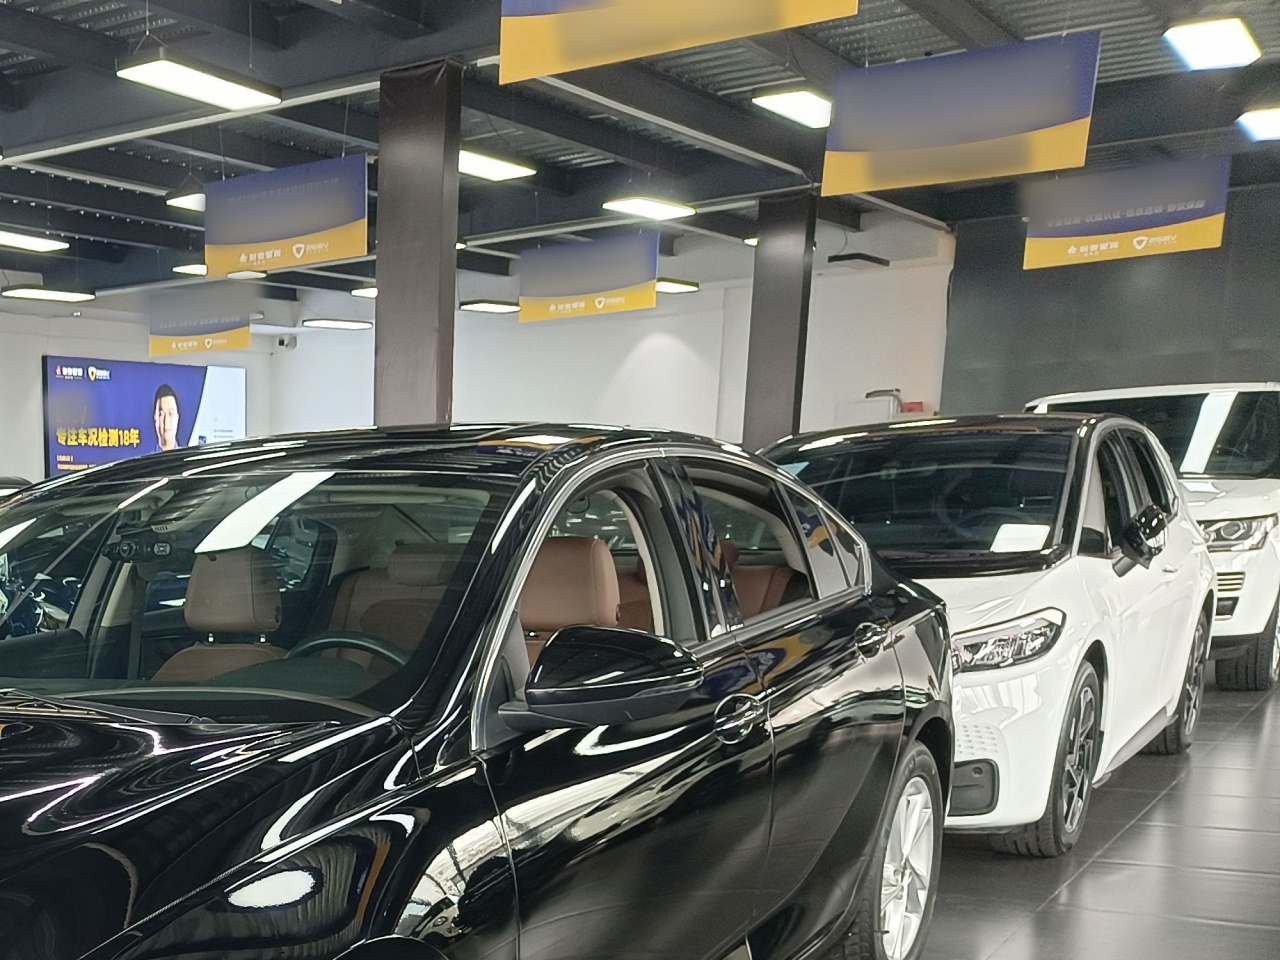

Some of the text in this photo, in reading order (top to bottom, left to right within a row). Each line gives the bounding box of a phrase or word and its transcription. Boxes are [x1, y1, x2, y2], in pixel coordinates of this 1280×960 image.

[56, 427, 140, 449] 专注车况检测18年
